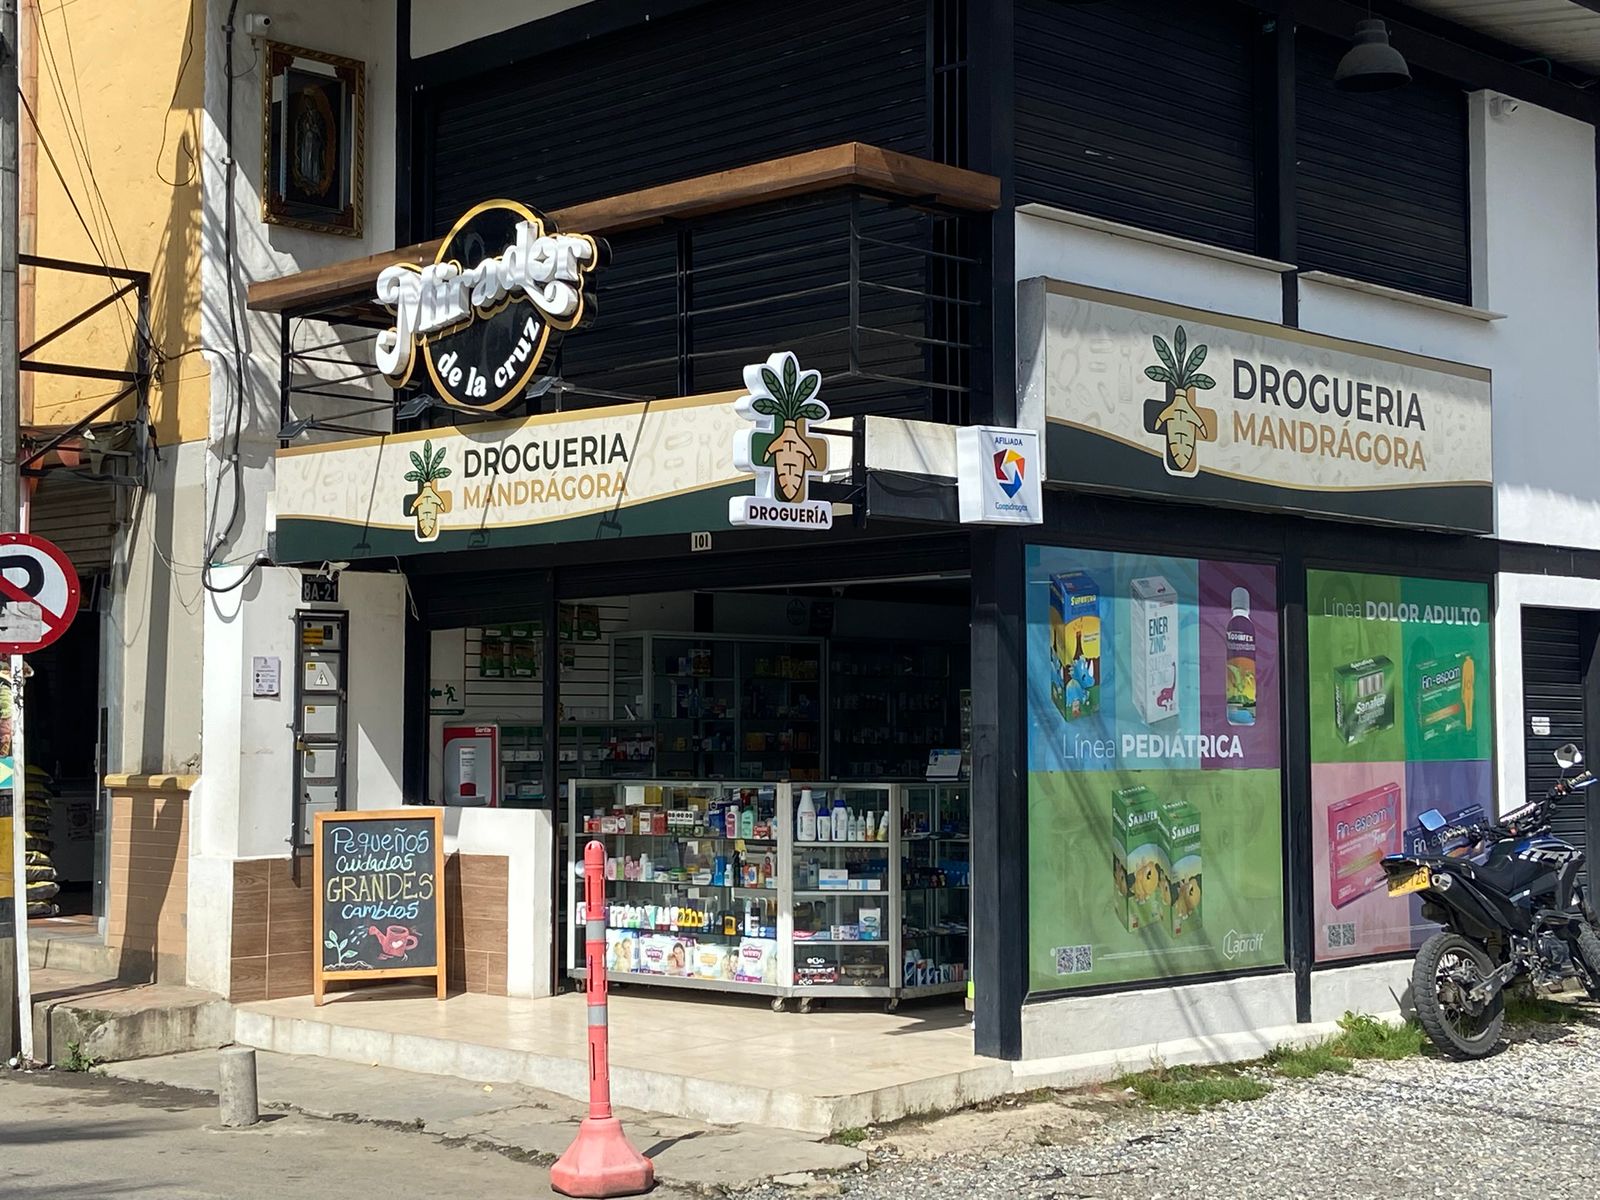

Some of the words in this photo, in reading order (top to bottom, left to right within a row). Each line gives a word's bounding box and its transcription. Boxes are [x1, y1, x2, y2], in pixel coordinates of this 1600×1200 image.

[375, 219, 594, 376] Mirador
[438, 352, 463, 387] de
[465, 366, 488, 397] la
[494, 316, 541, 389] cruz
[1233, 358, 1426, 431] DROGUERIA
[463, 432, 629, 478] DROGUERIA
[1233, 409, 1427, 472] MANDRÁGORA
[463, 470, 629, 510] MANDRÁGORA
[749, 504, 828, 525] DROGUERÍA
[694, 534, 709, 549] 101
[304, 582, 337, 601] 8A-21
[1148, 616, 1169, 637] ENER
[1322, 597, 1362, 619] Línea
[1366, 600, 1419, 624] DOLOR
[1423, 603, 1481, 626] ADULTO
[1062, 733, 1117, 759] Línea
[1121, 728, 1244, 759] PEDIÁTRICA
[330, 826, 430, 857] Pequeños
[335, 852, 416, 874] Cuidados
[326, 871, 434, 902] GRANDES
